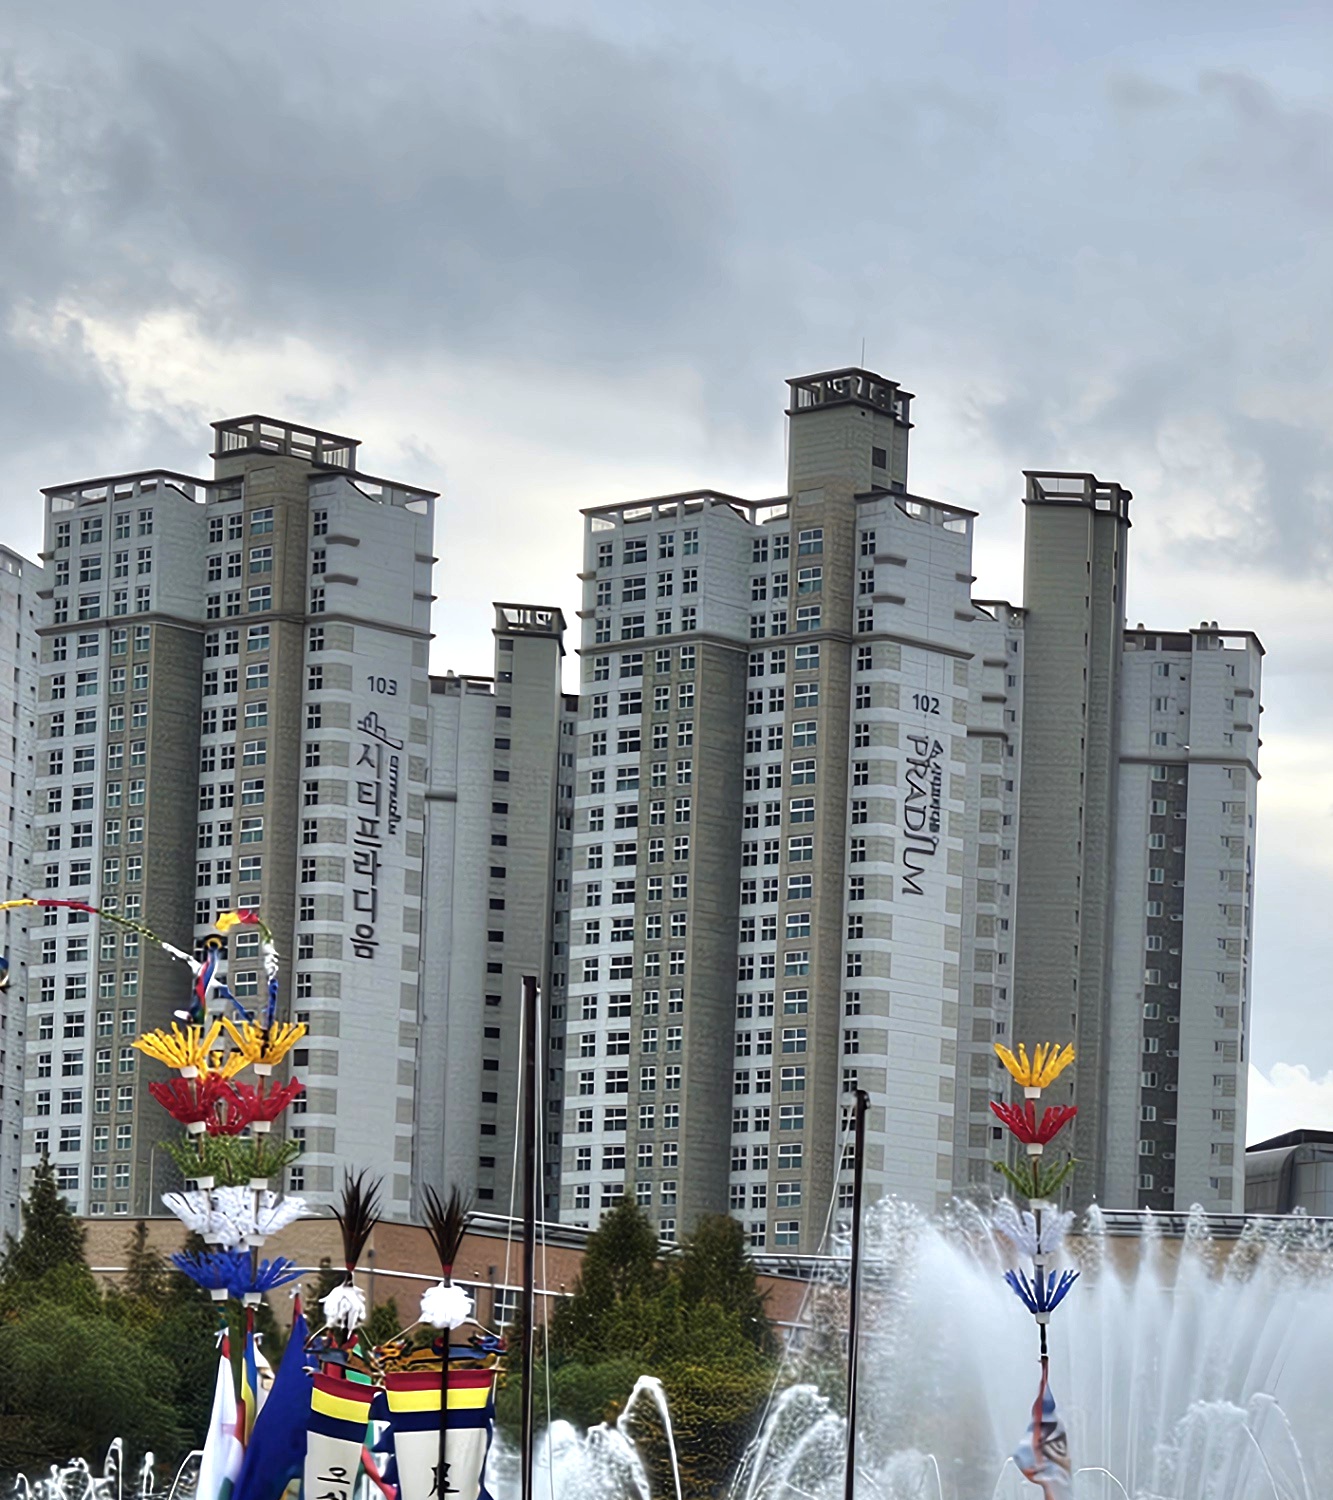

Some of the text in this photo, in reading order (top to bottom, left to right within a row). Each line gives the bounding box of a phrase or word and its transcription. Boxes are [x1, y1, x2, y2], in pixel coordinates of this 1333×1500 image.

[367, 676, 398, 696] 103
[912, 693, 941, 715] 102
[350, 743, 384, 960] 시티프라디움
